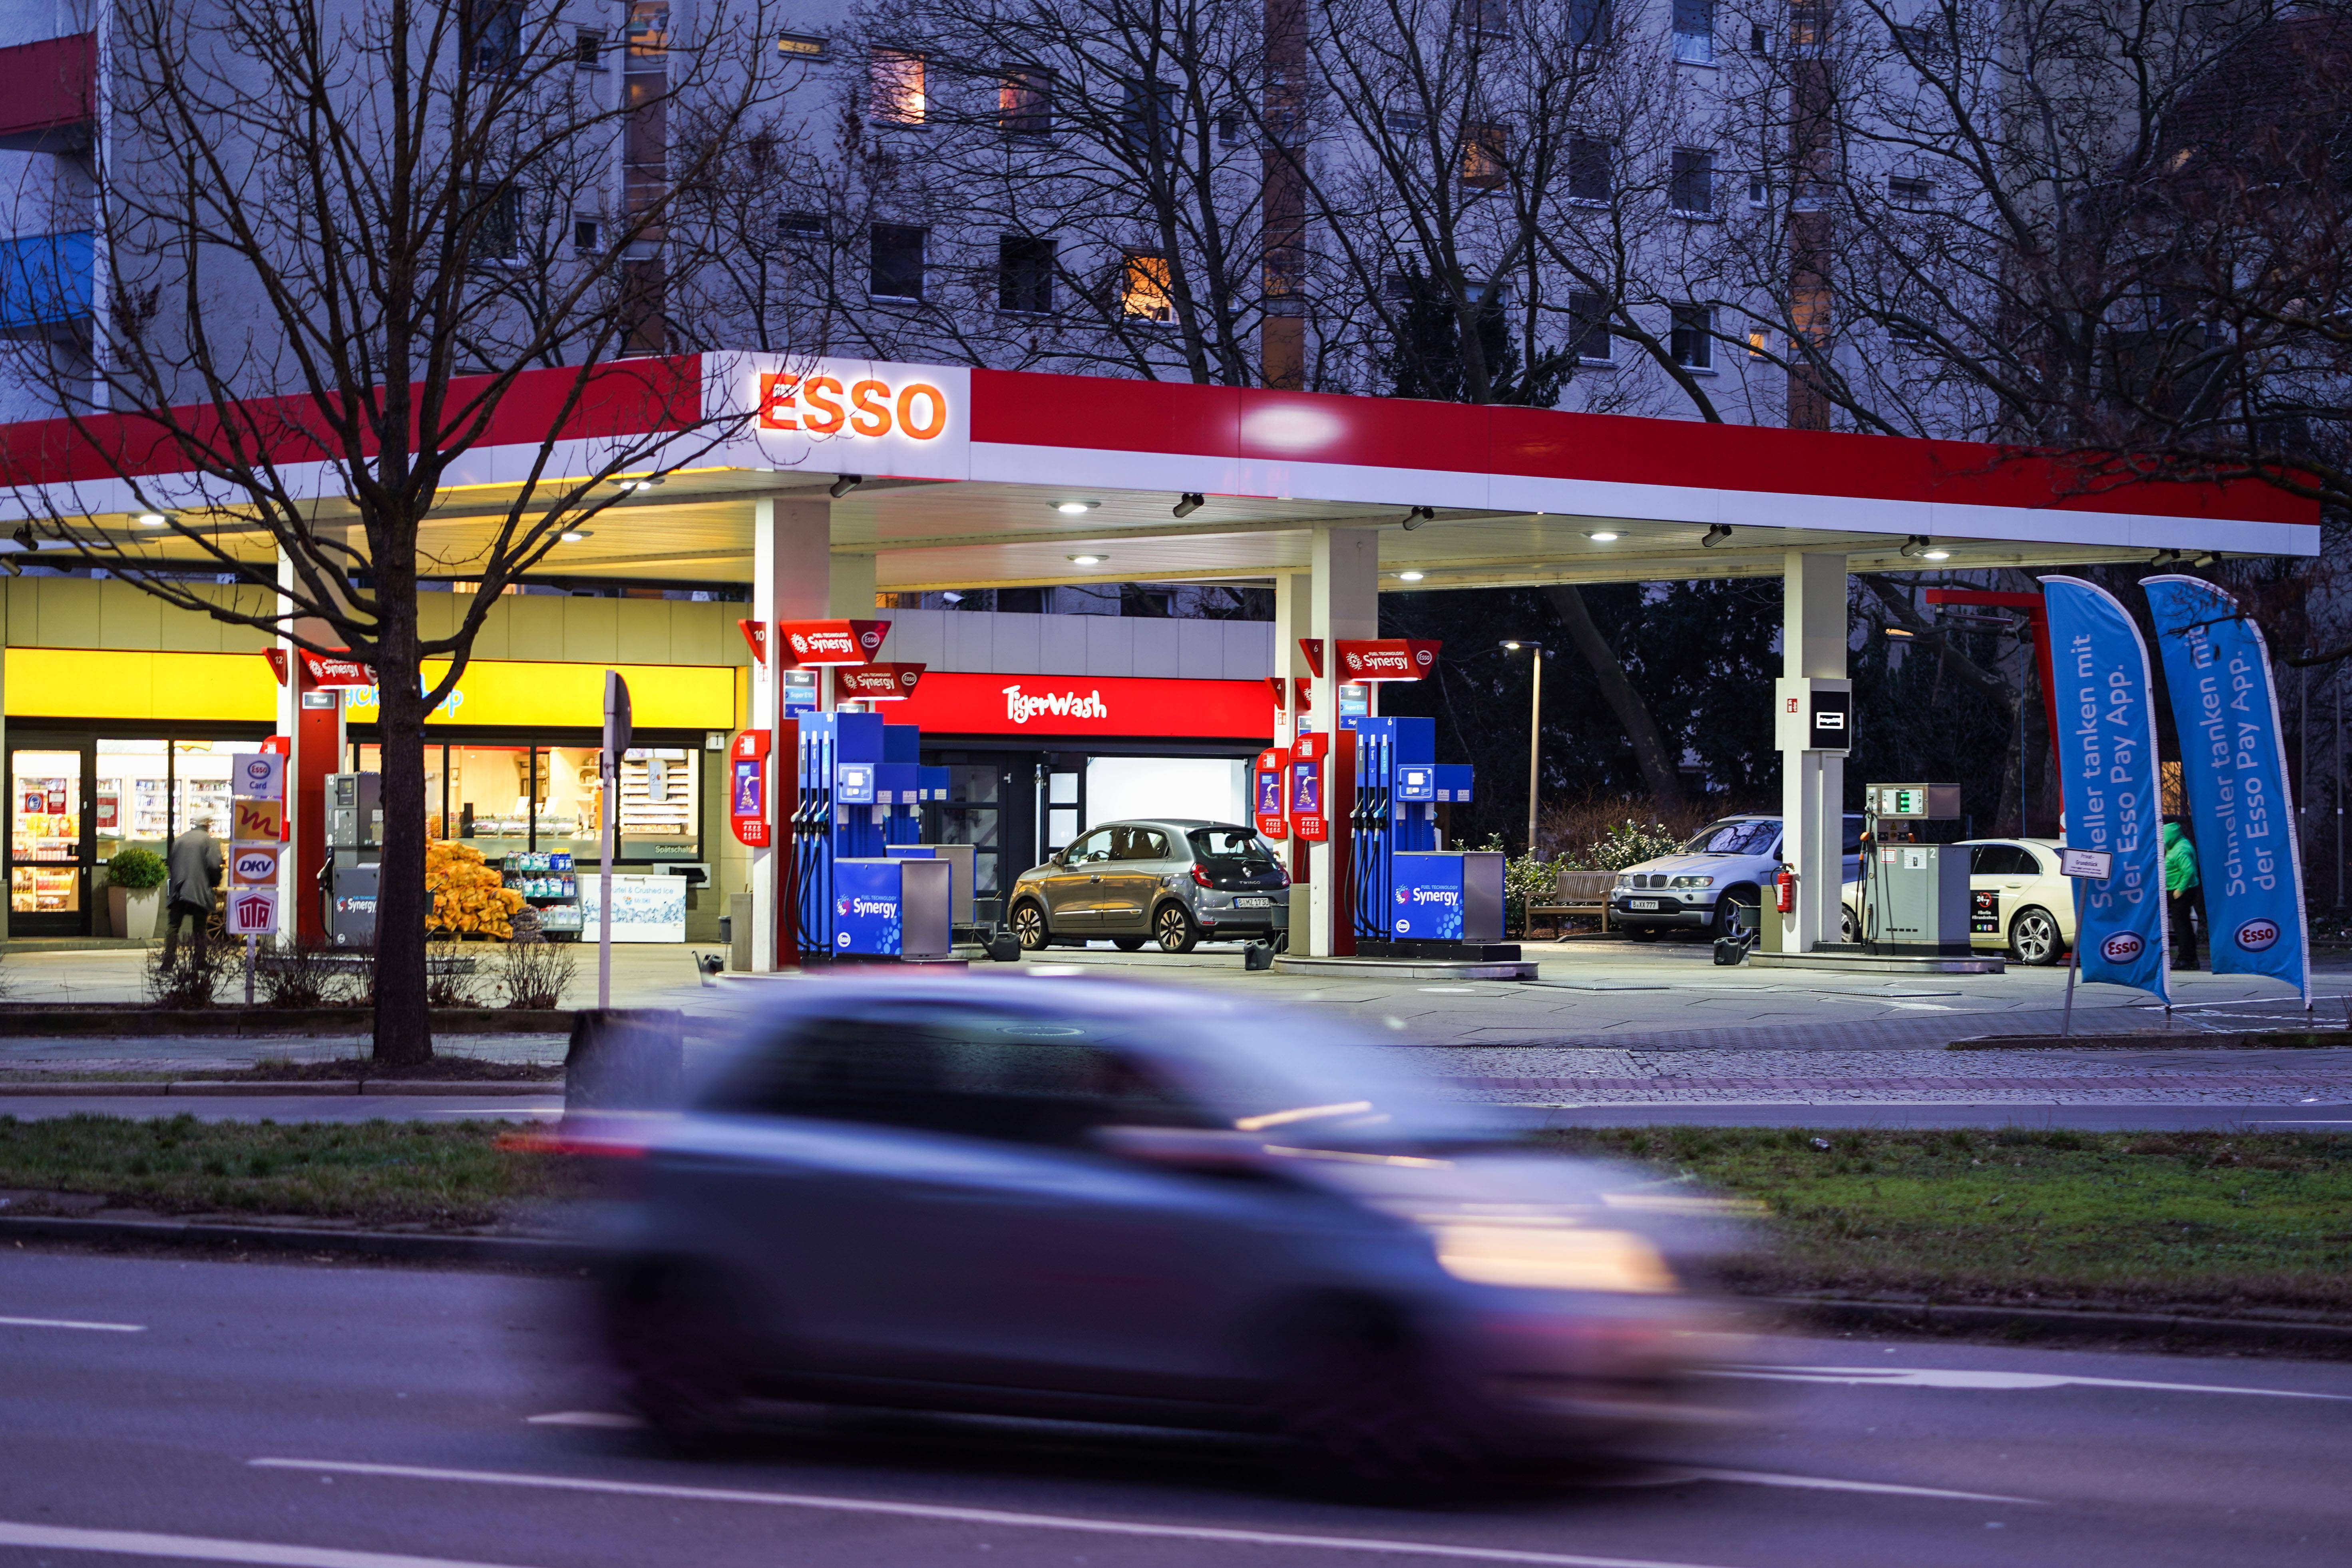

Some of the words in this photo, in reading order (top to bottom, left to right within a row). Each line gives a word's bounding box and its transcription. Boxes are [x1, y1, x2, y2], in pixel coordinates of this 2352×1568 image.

[760, 373, 946, 440] ESSO
[754, 630, 765, 641] 10
[807, 636, 854, 653] Synergy
[864, 635, 878, 644] Esso
[2071, 634, 2093, 678] mit
[2184, 625, 2212, 670] mit
[275, 656, 283, 665] 12
[322, 662, 359, 677] Synergy
[1363, 655, 1408, 670] Synergy
[857, 675, 895, 690] Synergy
[2230, 650, 2254, 712] App.
[1002, 685, 1107, 724] TigerWash
[2105, 665, 2134, 726] App.
[826, 713, 834, 722] 10
[1387, 718, 1392, 726] 6
[2199, 676, 2230, 768] tanken
[716, 735, 719, 746] 1
[2075, 686, 2101, 779] tanken
[2236, 722, 2260, 770] Pay
[2110, 735, 2137, 784] Pay
[249, 781, 267, 790] Card
[327, 775, 335, 786] 12
[2245, 777, 2269, 839] Esso
[2116, 792, 2139, 853] Esso
[2215, 776, 2246, 897] Schneller
[1929, 848, 1936, 859] 2
[239, 860, 273, 872] DKV
[2252, 847, 2276, 890] der
[2119, 861, 2144, 904] der
[347, 897, 377, 914] Synergy
[1413, 887, 1459, 906] Synergy
[239, 897, 271, 928] UTA
[854, 897, 897, 919] Synergy
[2242, 928, 2274, 943] Esso
[2107, 940, 2139, 955] Esso
